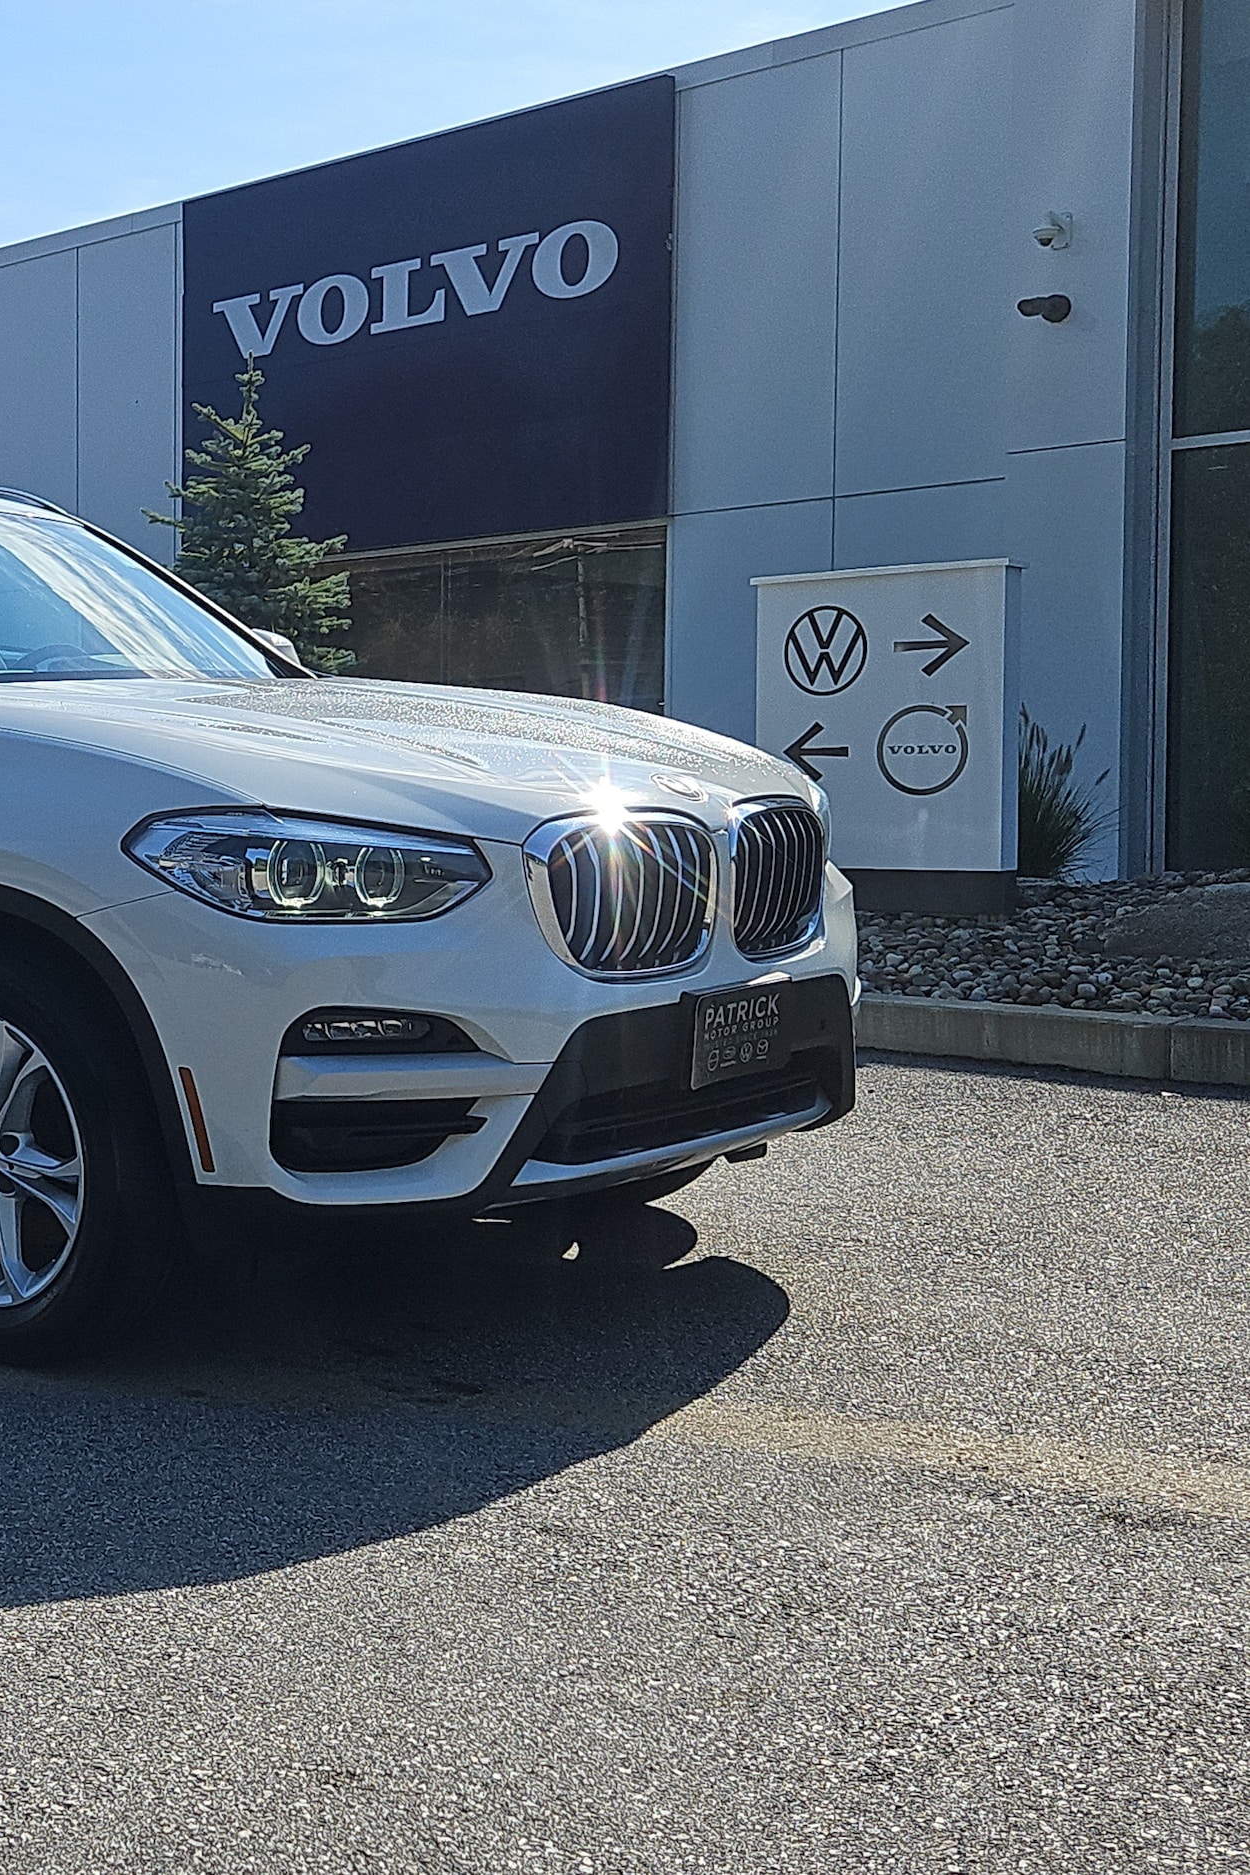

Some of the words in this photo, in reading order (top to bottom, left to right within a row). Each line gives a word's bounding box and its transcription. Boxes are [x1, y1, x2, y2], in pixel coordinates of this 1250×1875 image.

[212, 219, 619, 359] VOLVO
[887, 744, 958, 755] VOLVO
[704, 992, 781, 1030] PATRICK
[703, 1024, 738, 1041] MOTOR
[742, 1016, 779, 1032] GROUP
